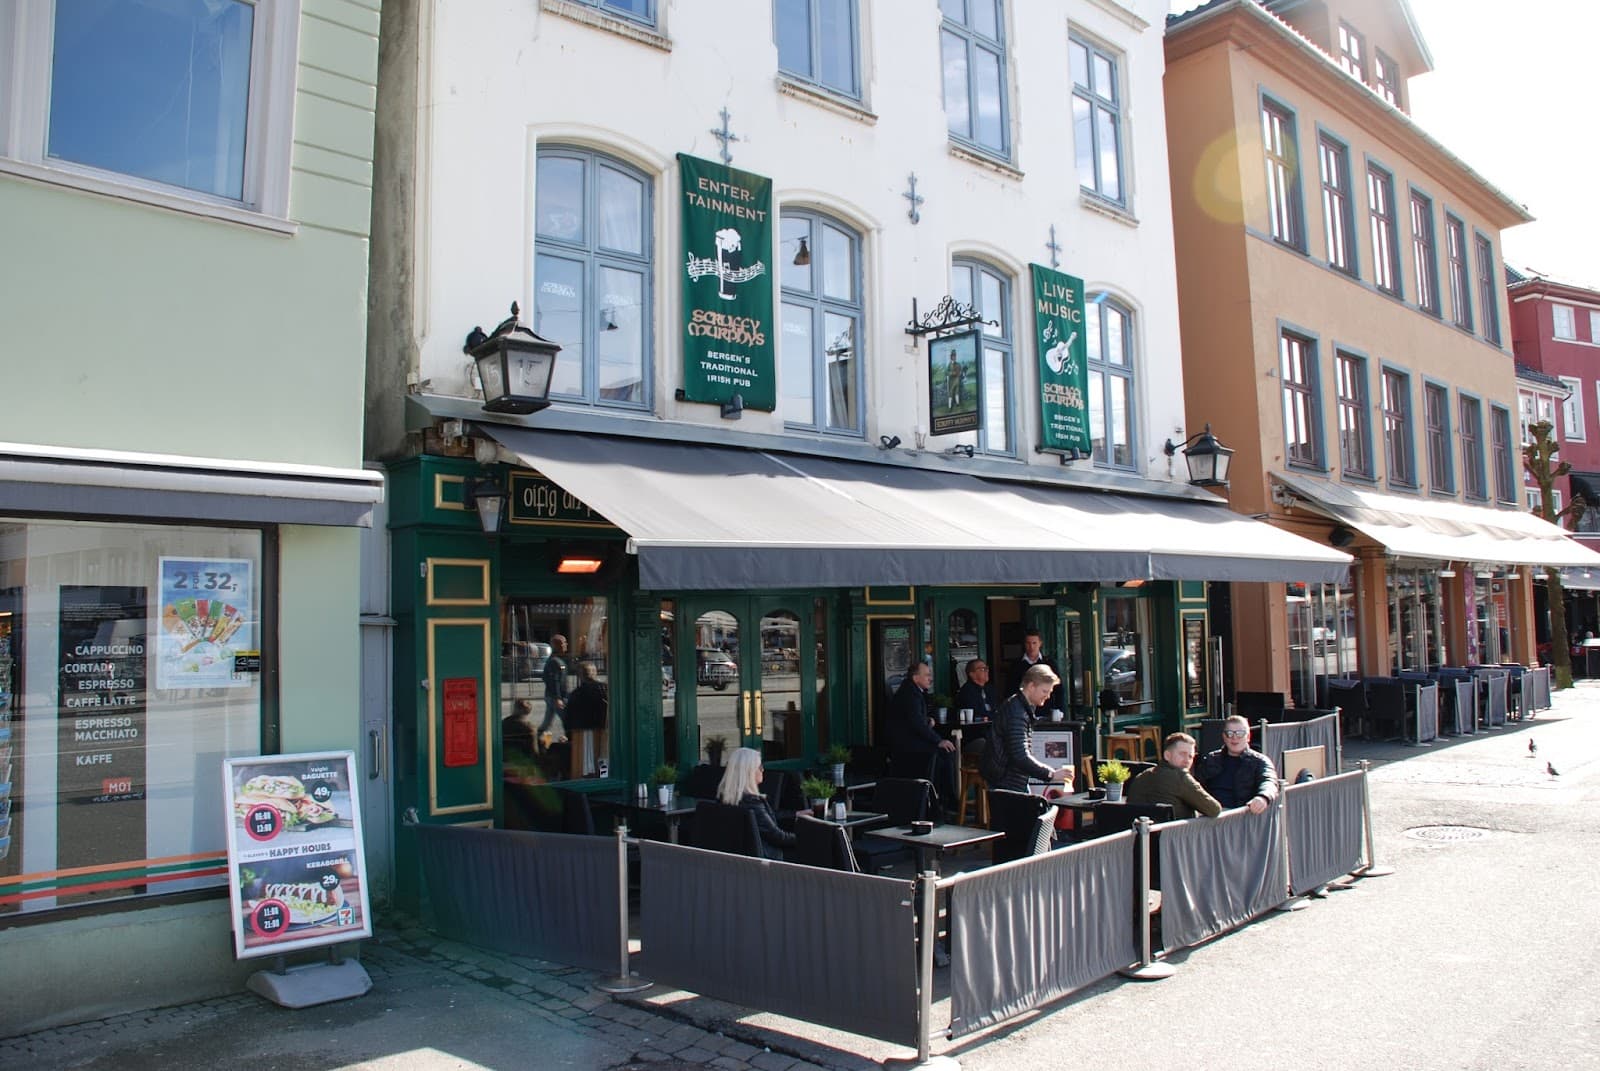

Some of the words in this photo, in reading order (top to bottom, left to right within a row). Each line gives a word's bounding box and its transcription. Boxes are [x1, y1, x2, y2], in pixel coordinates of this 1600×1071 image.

[698, 177, 755, 202] ENTER-
[686, 191, 767, 222] TAINMENT
[1043, 281, 1074, 303] LIVE
[1038, 298, 1081, 323] MUSIC
[707, 350, 751, 364] BERGEN'S
[700, 361, 758, 377] TRADITIONAL
[707, 374, 731, 385] IRISH
[733, 378, 751, 387] PUB
[173, 571, 188, 589] 2
[75, 644, 144, 656] CAPPUCCINO
[64, 662, 116, 674] CORTADO
[78, 679, 135, 690] ESPRESSO
[66, 694, 102, 708] CAFFÈ
[103, 695, 137, 706] LATTE
[75, 717, 132, 730] ESPRESSO
[75, 728, 138, 742] MACCHIATO
[76, 753, 113, 767] KAFFE
[301, 771, 338, 780] BAGUETTE
[269, 846, 300, 858] HAPPY
[301, 842, 332, 854] HOURS
